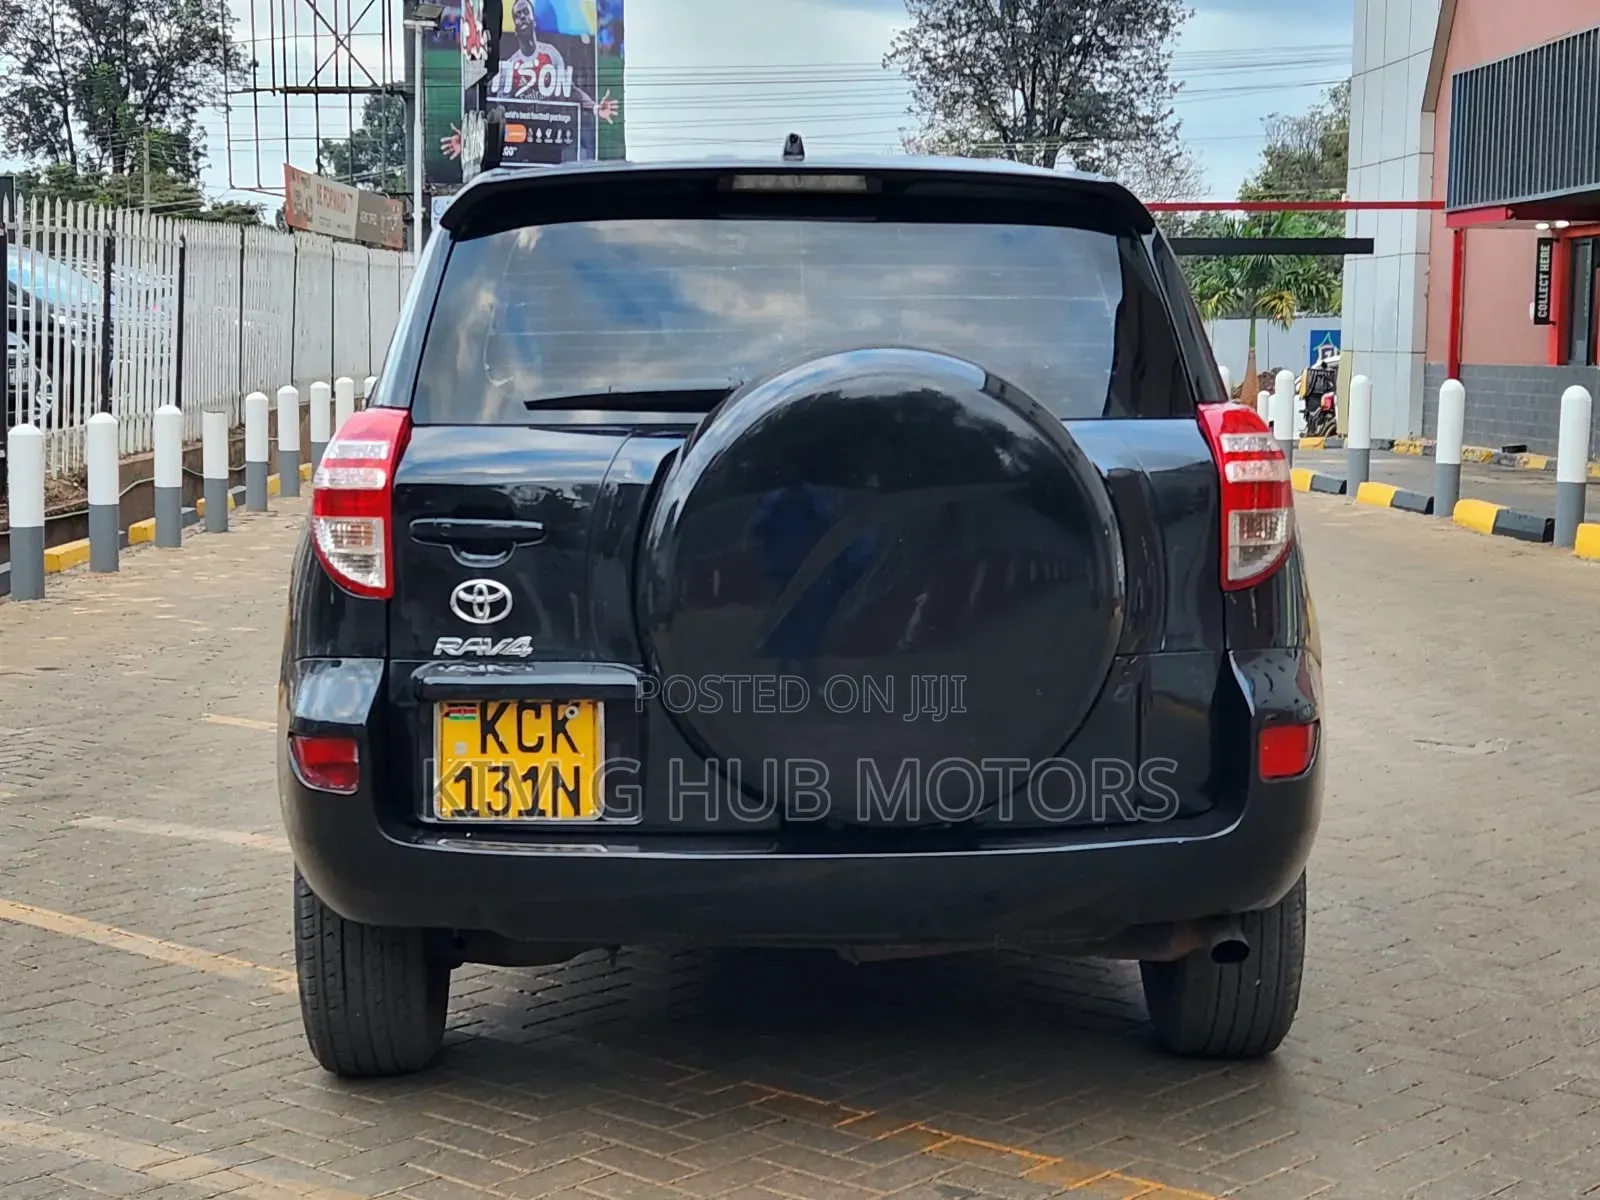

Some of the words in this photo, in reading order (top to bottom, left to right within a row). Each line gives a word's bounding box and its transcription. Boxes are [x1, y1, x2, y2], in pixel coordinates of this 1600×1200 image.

[538, 63, 573, 98] ON
[504, 110, 519, 119] orld's
[1540, 244, 1551, 272] HERE
[1538, 273, 1549, 318] COLLECT
[432, 635, 534, 657] RAV4
[479, 701, 581, 754] KCK
[451, 765, 581, 817] 131N
